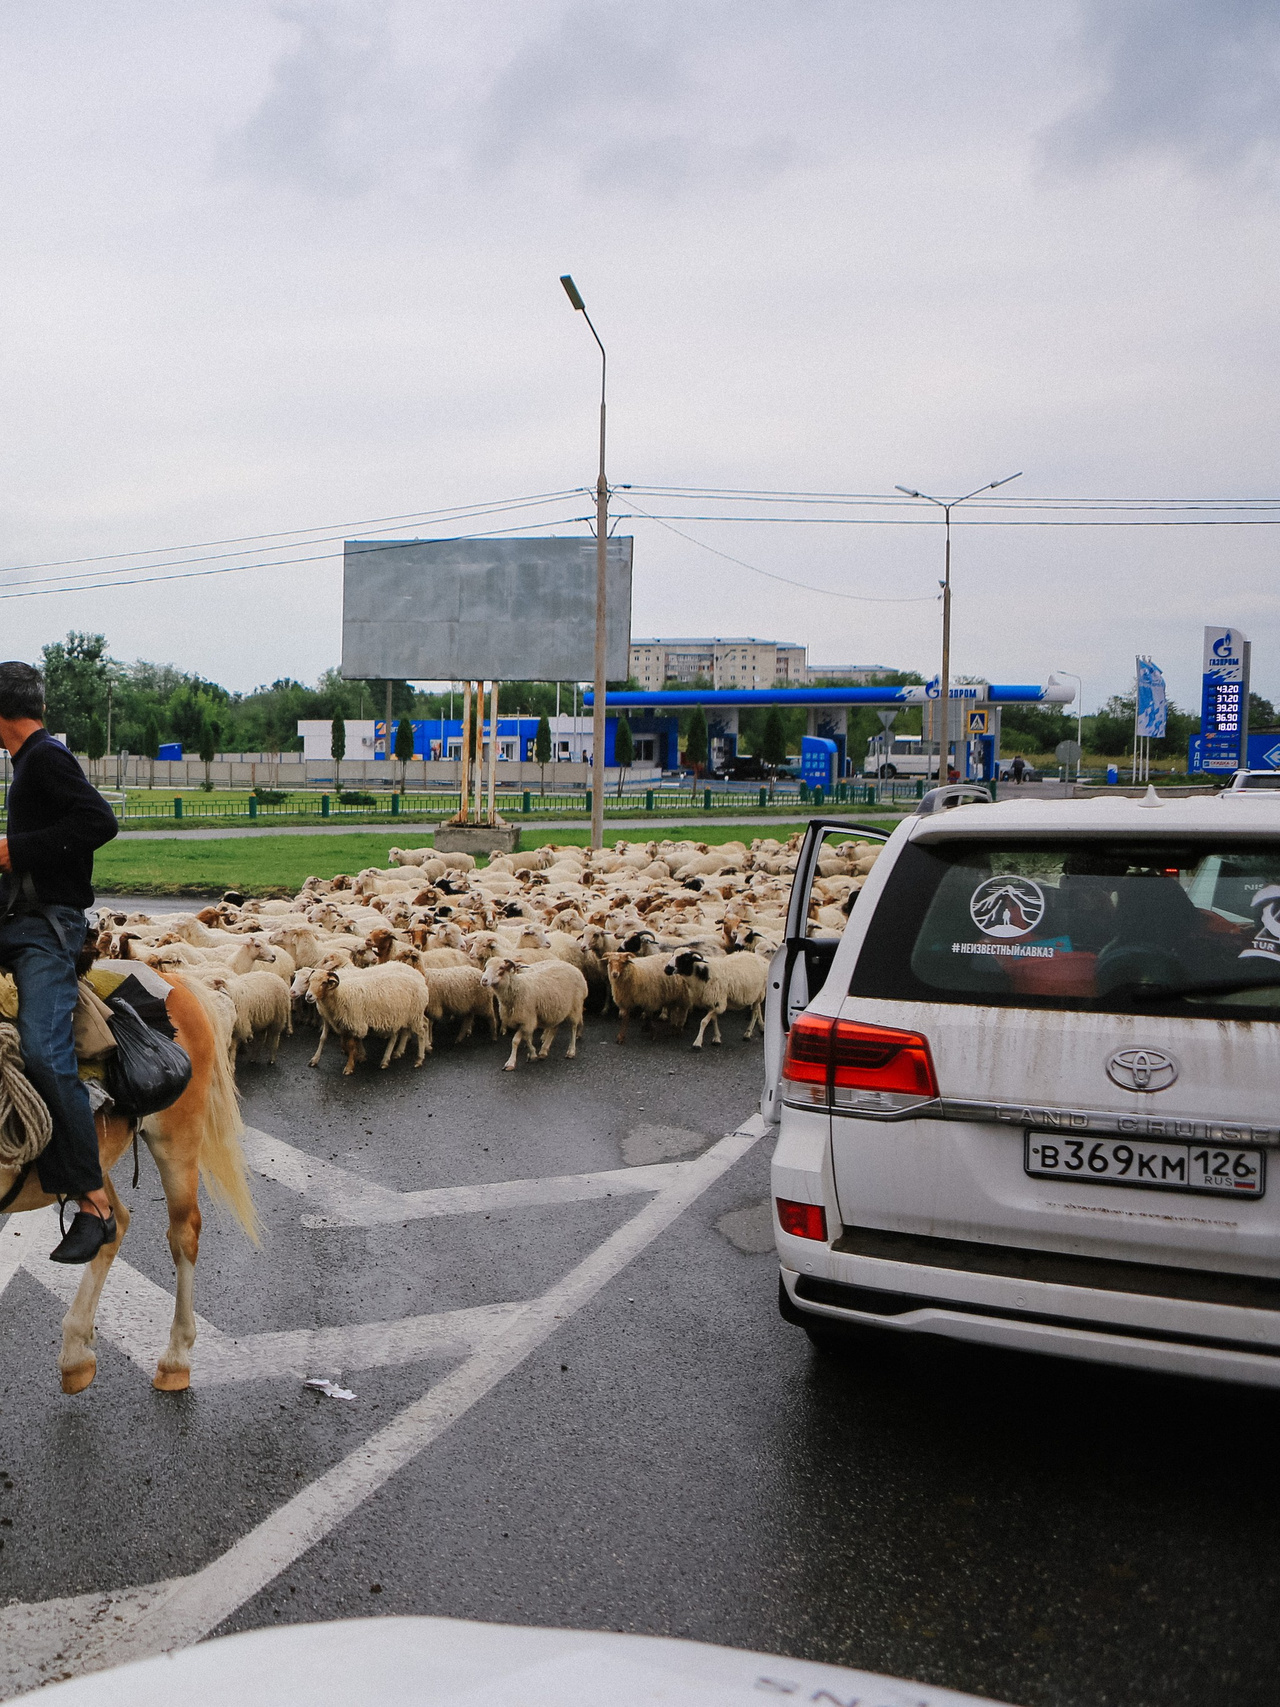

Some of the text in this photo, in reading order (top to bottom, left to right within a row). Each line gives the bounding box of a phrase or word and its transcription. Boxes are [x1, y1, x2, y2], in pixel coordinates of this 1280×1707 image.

[941, 689, 977, 698] ЗПРОМ
[1216, 685, 1239, 693] 43.20
[1216, 694, 1239, 703] 37.20
[1216, 704, 1239, 712] 39.20
[1215, 713, 1238, 722] 36.90
[951, 942, 1055, 958] #НЕИЗВЕСТНЫЙКАВКАЗ
[995, 1106, 1280, 1143] LAND CRUISE
[1041, 1140, 1251, 1181] В369КМ 126
[1204, 1175, 1233, 1187] RUS
